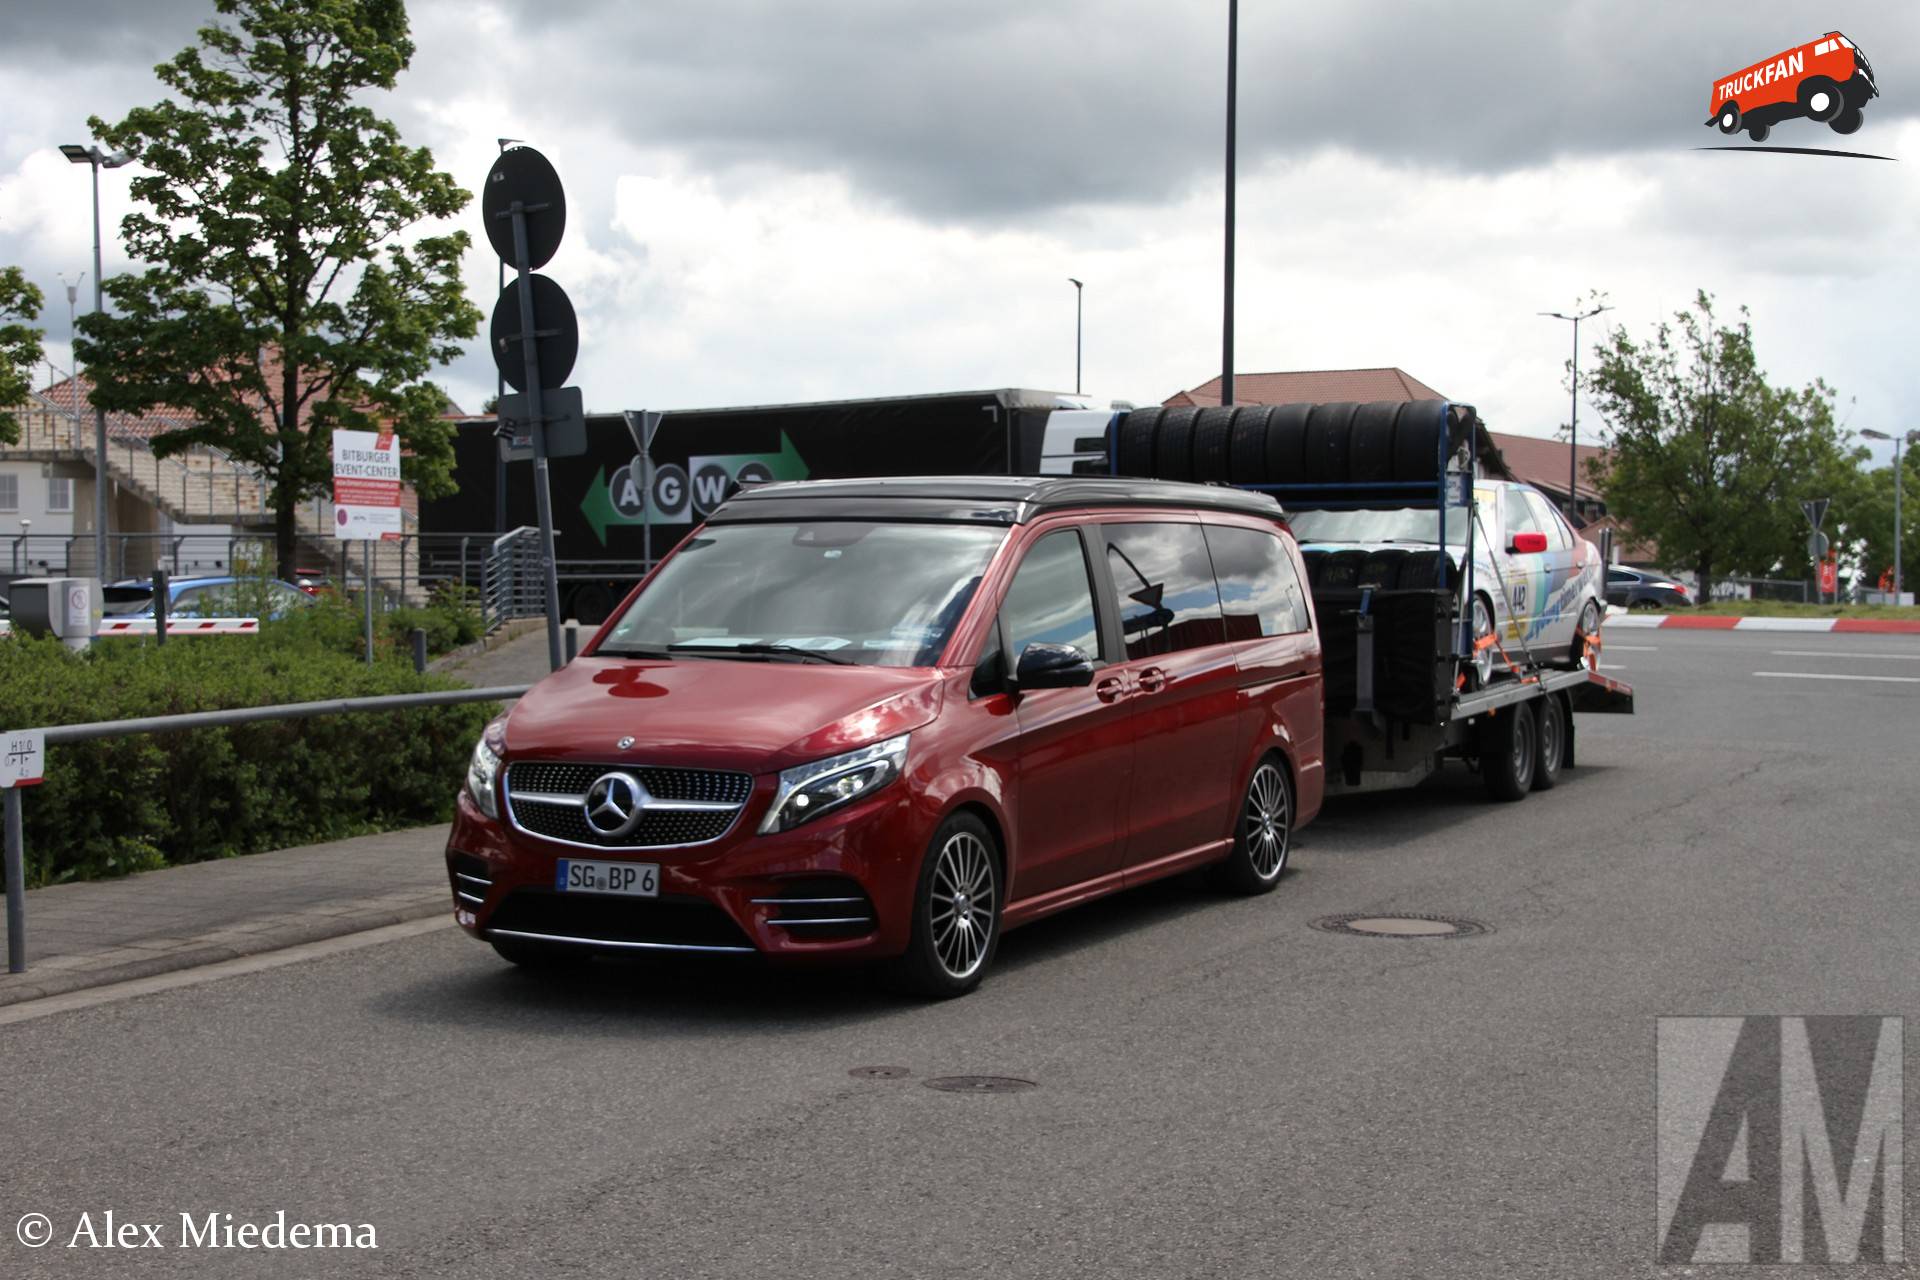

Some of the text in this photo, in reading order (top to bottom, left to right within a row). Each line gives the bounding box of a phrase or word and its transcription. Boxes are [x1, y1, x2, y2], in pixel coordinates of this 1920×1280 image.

[342, 449, 391, 463] BITBURGER
[335, 463, 399, 478] EVENT-CENTER
[618, 474, 764, 507] AGW
[1512, 585, 1526, 612] 442
[569, 864, 656, 892] SG BP 6
